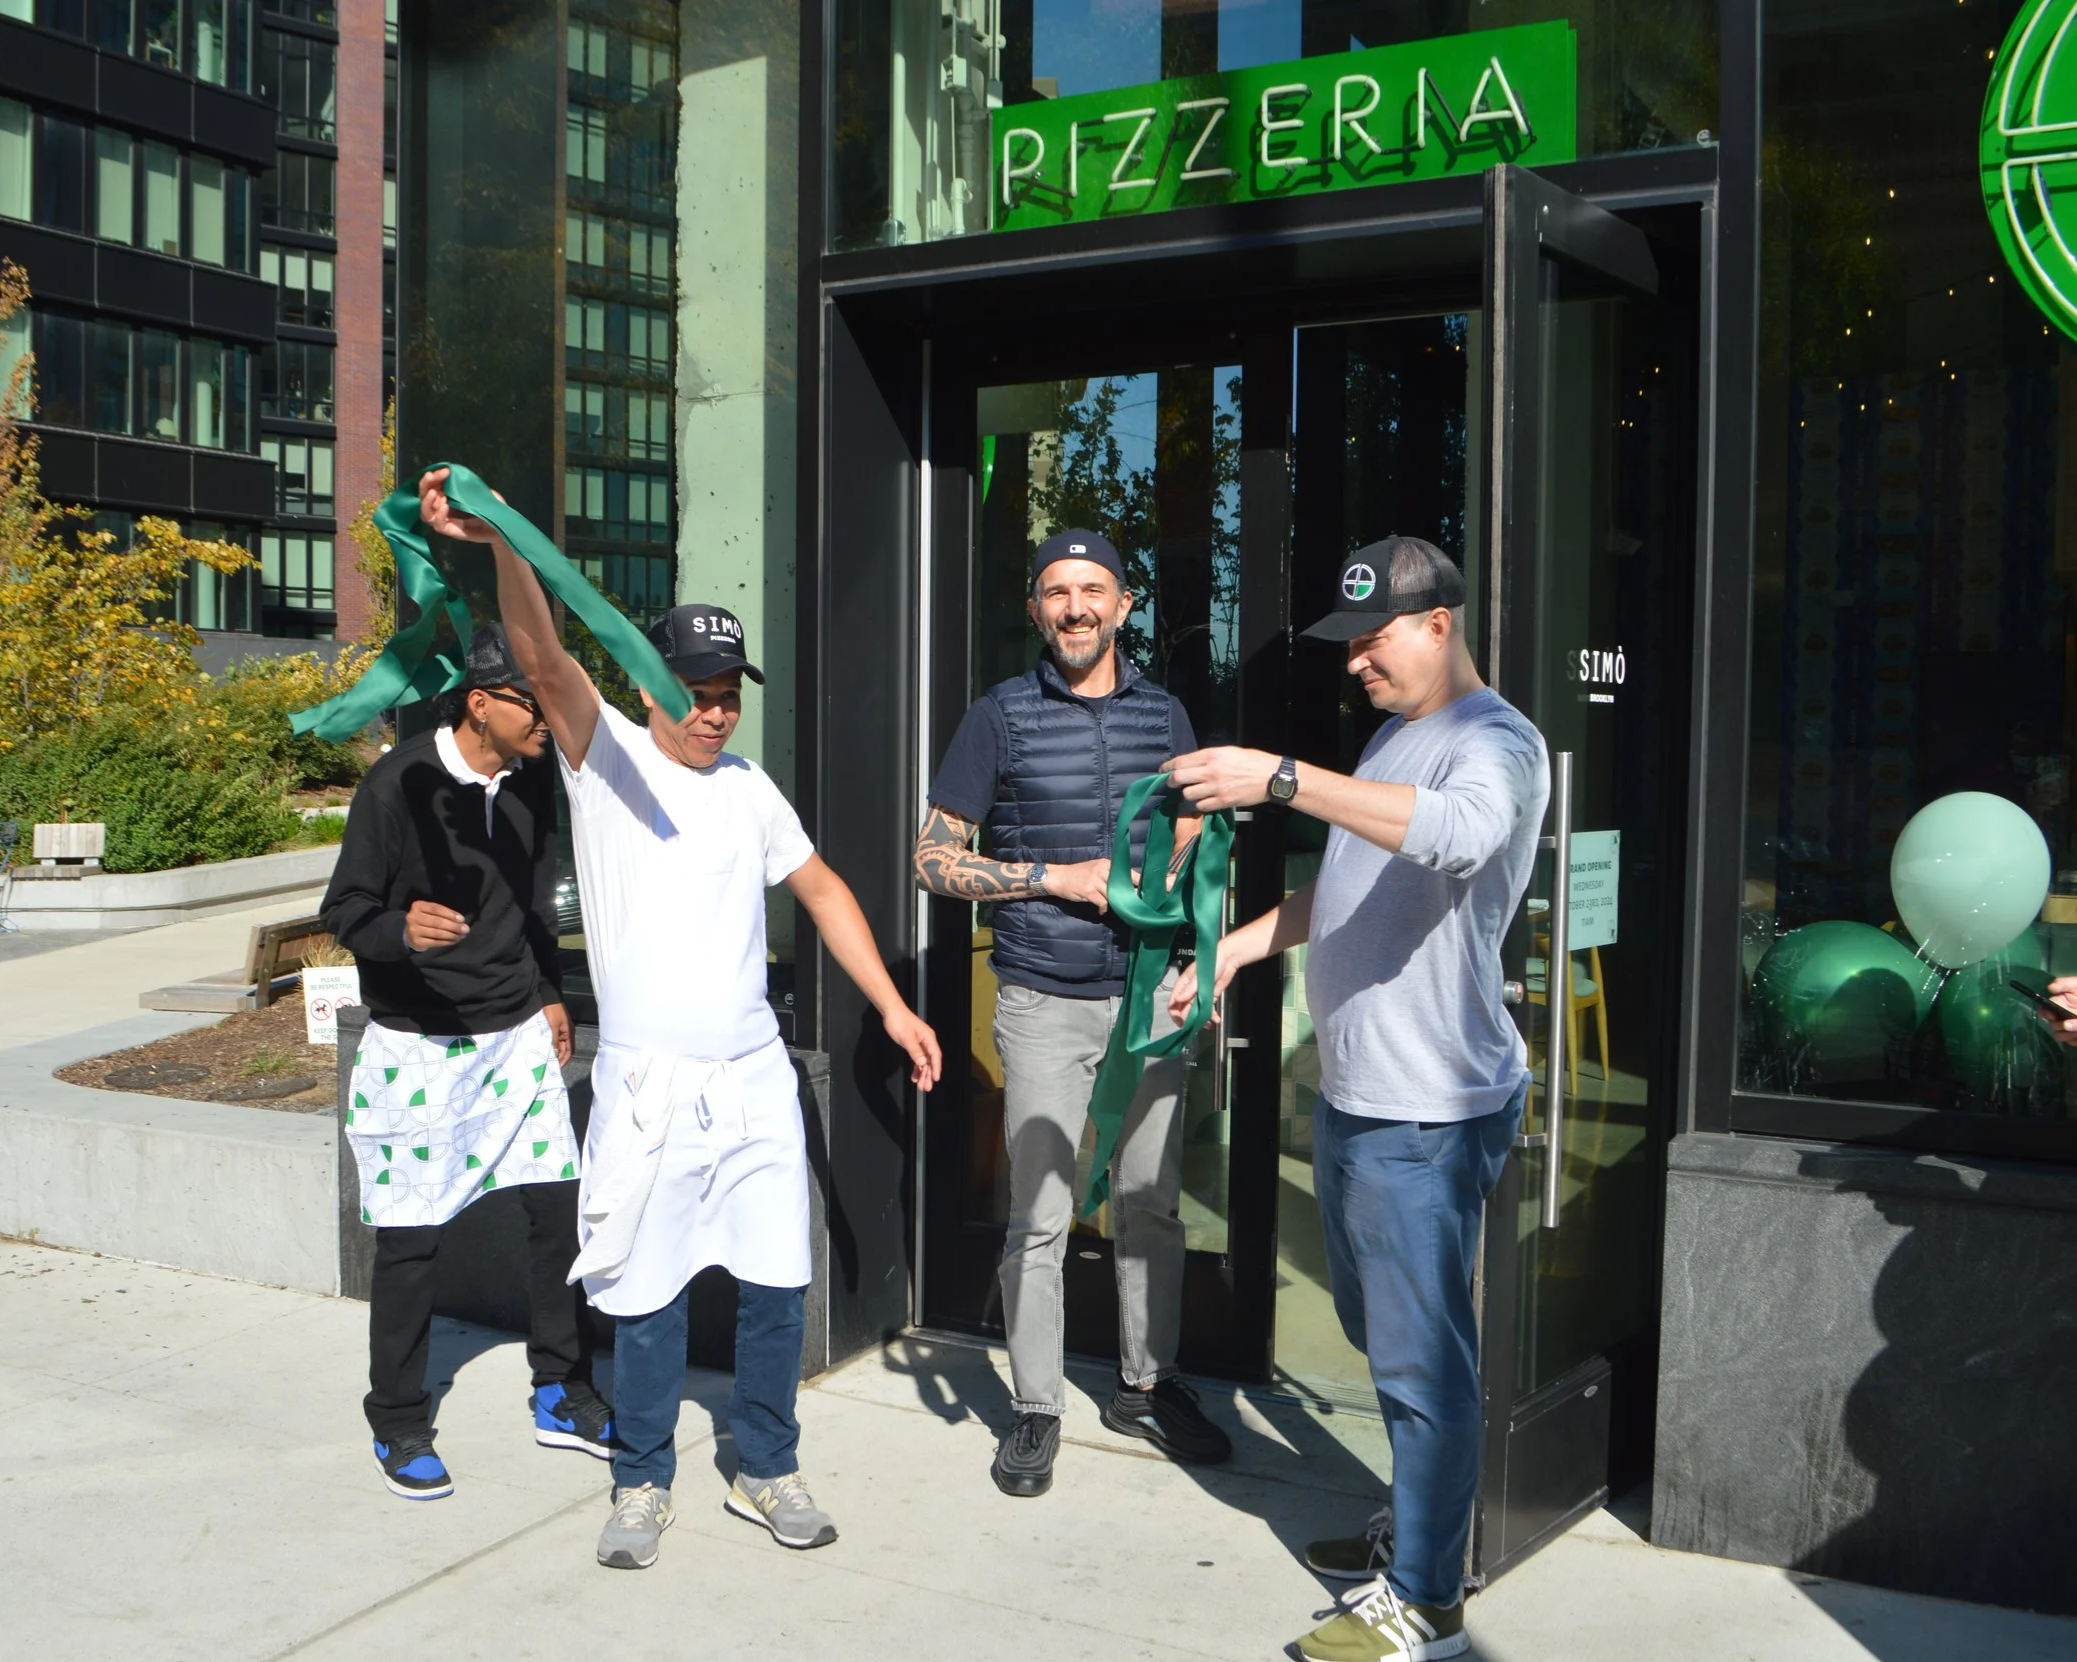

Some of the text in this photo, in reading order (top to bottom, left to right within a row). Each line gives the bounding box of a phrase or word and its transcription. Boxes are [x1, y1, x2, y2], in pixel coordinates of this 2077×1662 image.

[1003, 56, 1530, 205] PIZZERIA
[1580, 645, 1626, 684] SIMÒ
[1570, 860, 1612, 873] RAND OPENING
